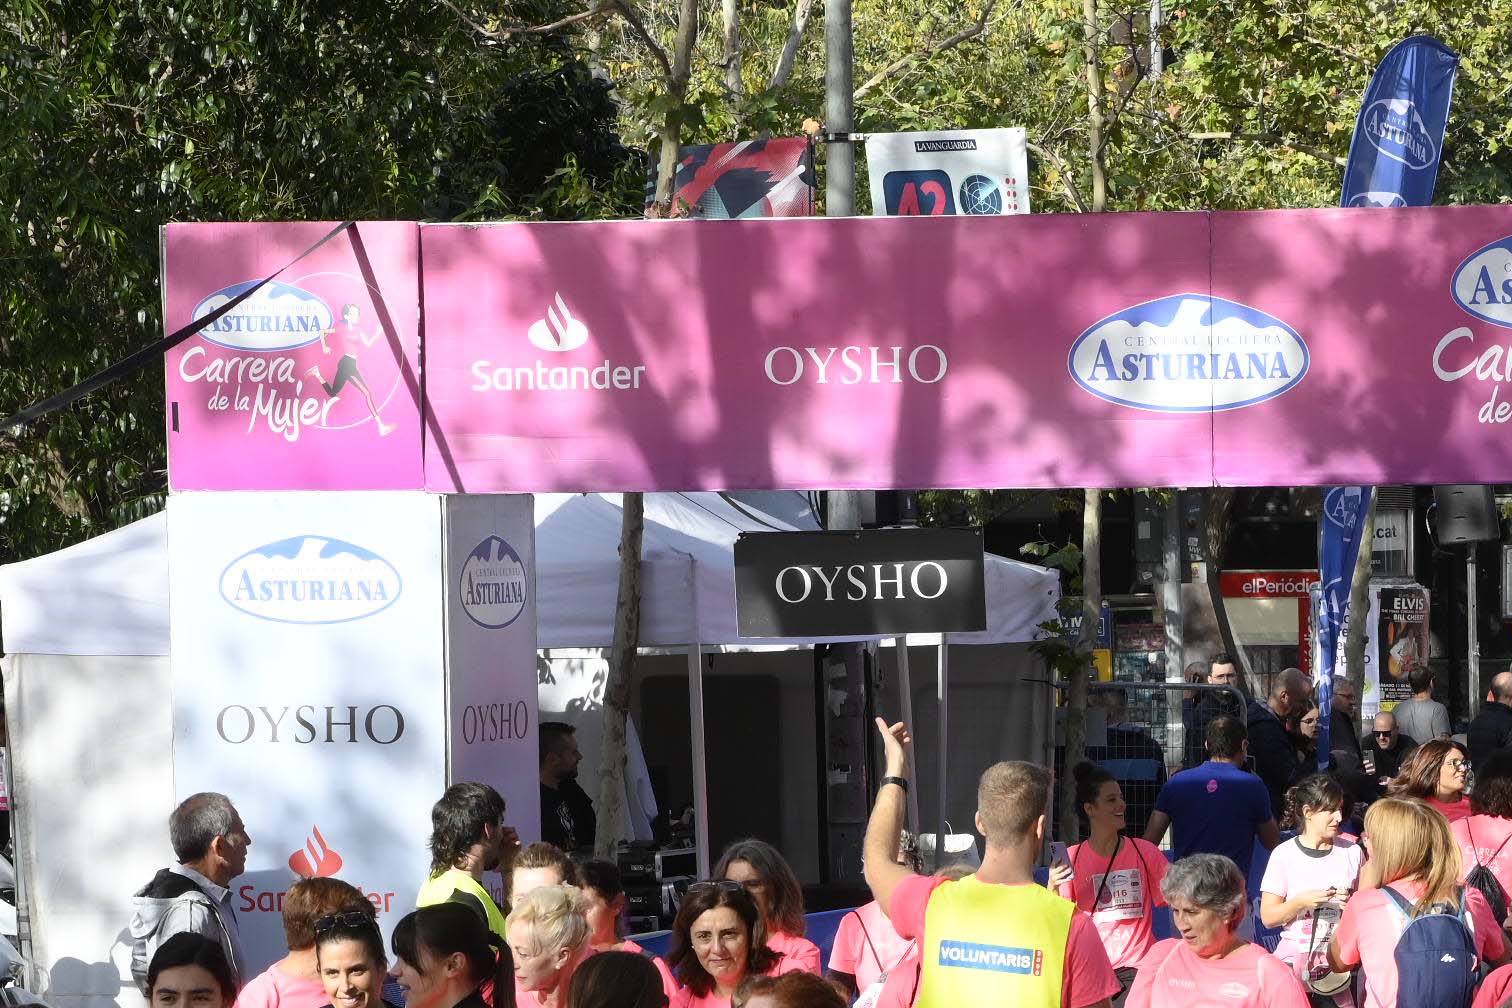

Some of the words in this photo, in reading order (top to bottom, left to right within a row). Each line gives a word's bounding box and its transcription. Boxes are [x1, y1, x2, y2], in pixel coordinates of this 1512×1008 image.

[928, 140, 975, 151] VANGUARDIA
[179, 345, 297, 384] Carrera
[472, 359, 646, 392] Santander
[764, 344, 949, 386] OYSHO
[1087, 338, 1292, 382] ASTURIANA
[207, 384, 230, 411] de
[234, 384, 251, 411] la
[248, 380, 340, 443] Mujer
[1478, 384, 1512, 423] de
[234, 568, 389, 602] ASTURIANA
[465, 572, 524, 607] ASTURIANA
[774, 561, 949, 604] OYSHO
[1394, 598, 1424, 610] ELVIS
[216, 704, 405, 744] OYSHO
[462, 701, 529, 745] OYSHO
[941, 946, 1031, 969] VOLUNTARIS
